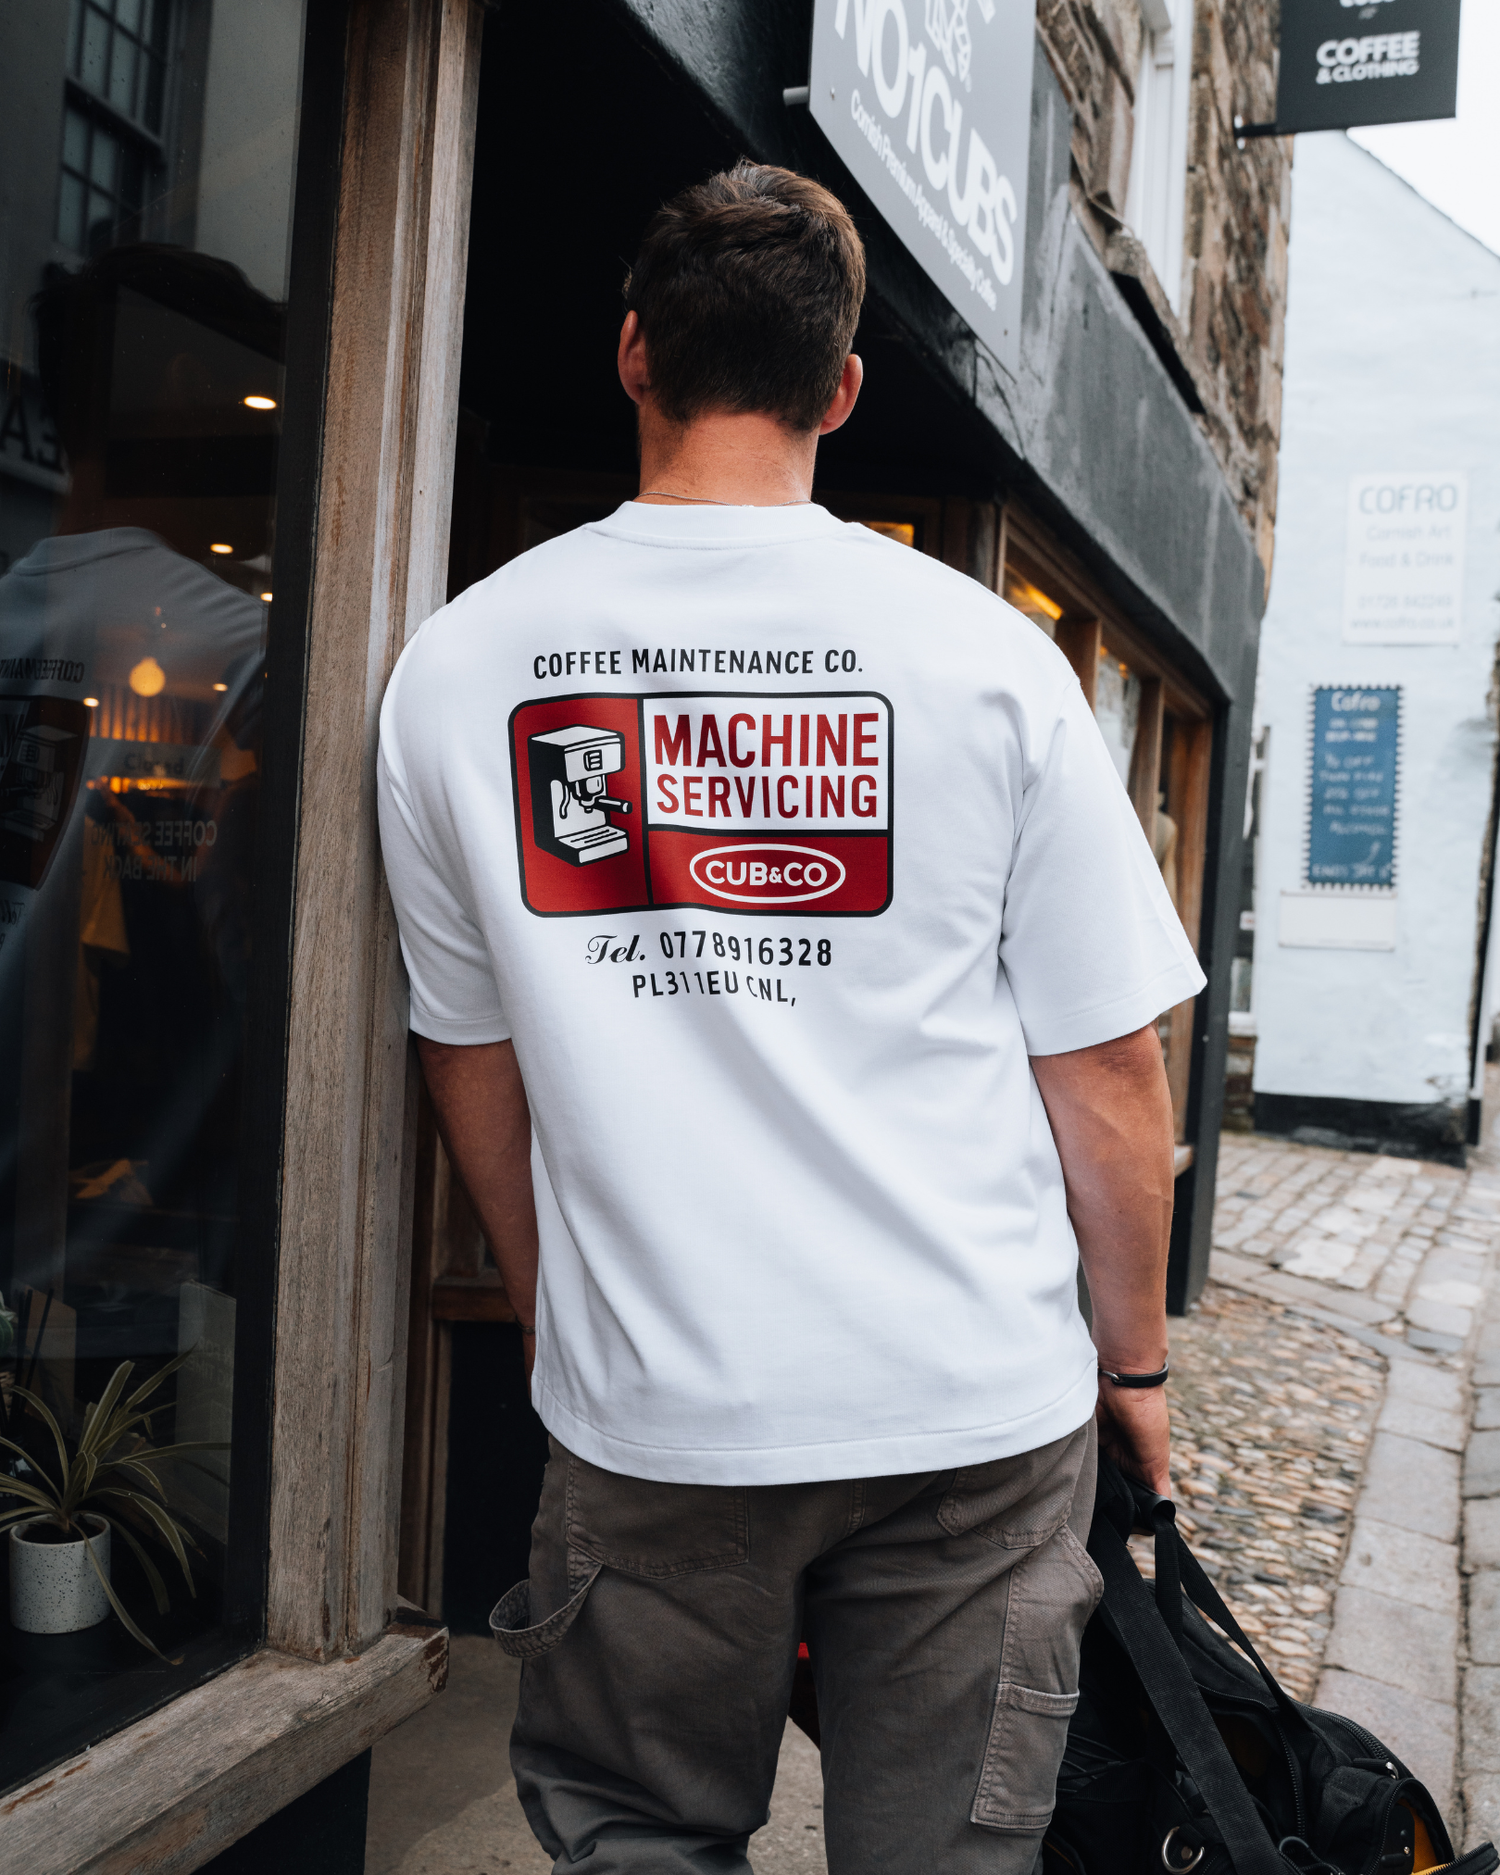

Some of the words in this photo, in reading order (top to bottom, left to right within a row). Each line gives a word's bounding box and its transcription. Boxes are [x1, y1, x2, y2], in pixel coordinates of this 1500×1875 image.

[1315, 30, 1421, 67] COFFEE
[1332, 58, 1420, 83] CLOTHING
[851, 89, 882, 156] Cornish
[1359, 483, 1458, 514] COFRO
[533, 650, 622, 680] COFFEE
[632, 648, 814, 674] MAINTENANCE
[824, 649, 864, 674] CO.
[1331, 691, 1381, 711] Cofro
[653, 712, 880, 768] MACHINE
[656, 774, 878, 819] SERVICING
[705, 860, 828, 887] CUB&CO
[585, 934, 646, 965] Tel.
[659, 930, 832, 966] 0778916328
[746, 975, 796, 1007] CNL,
